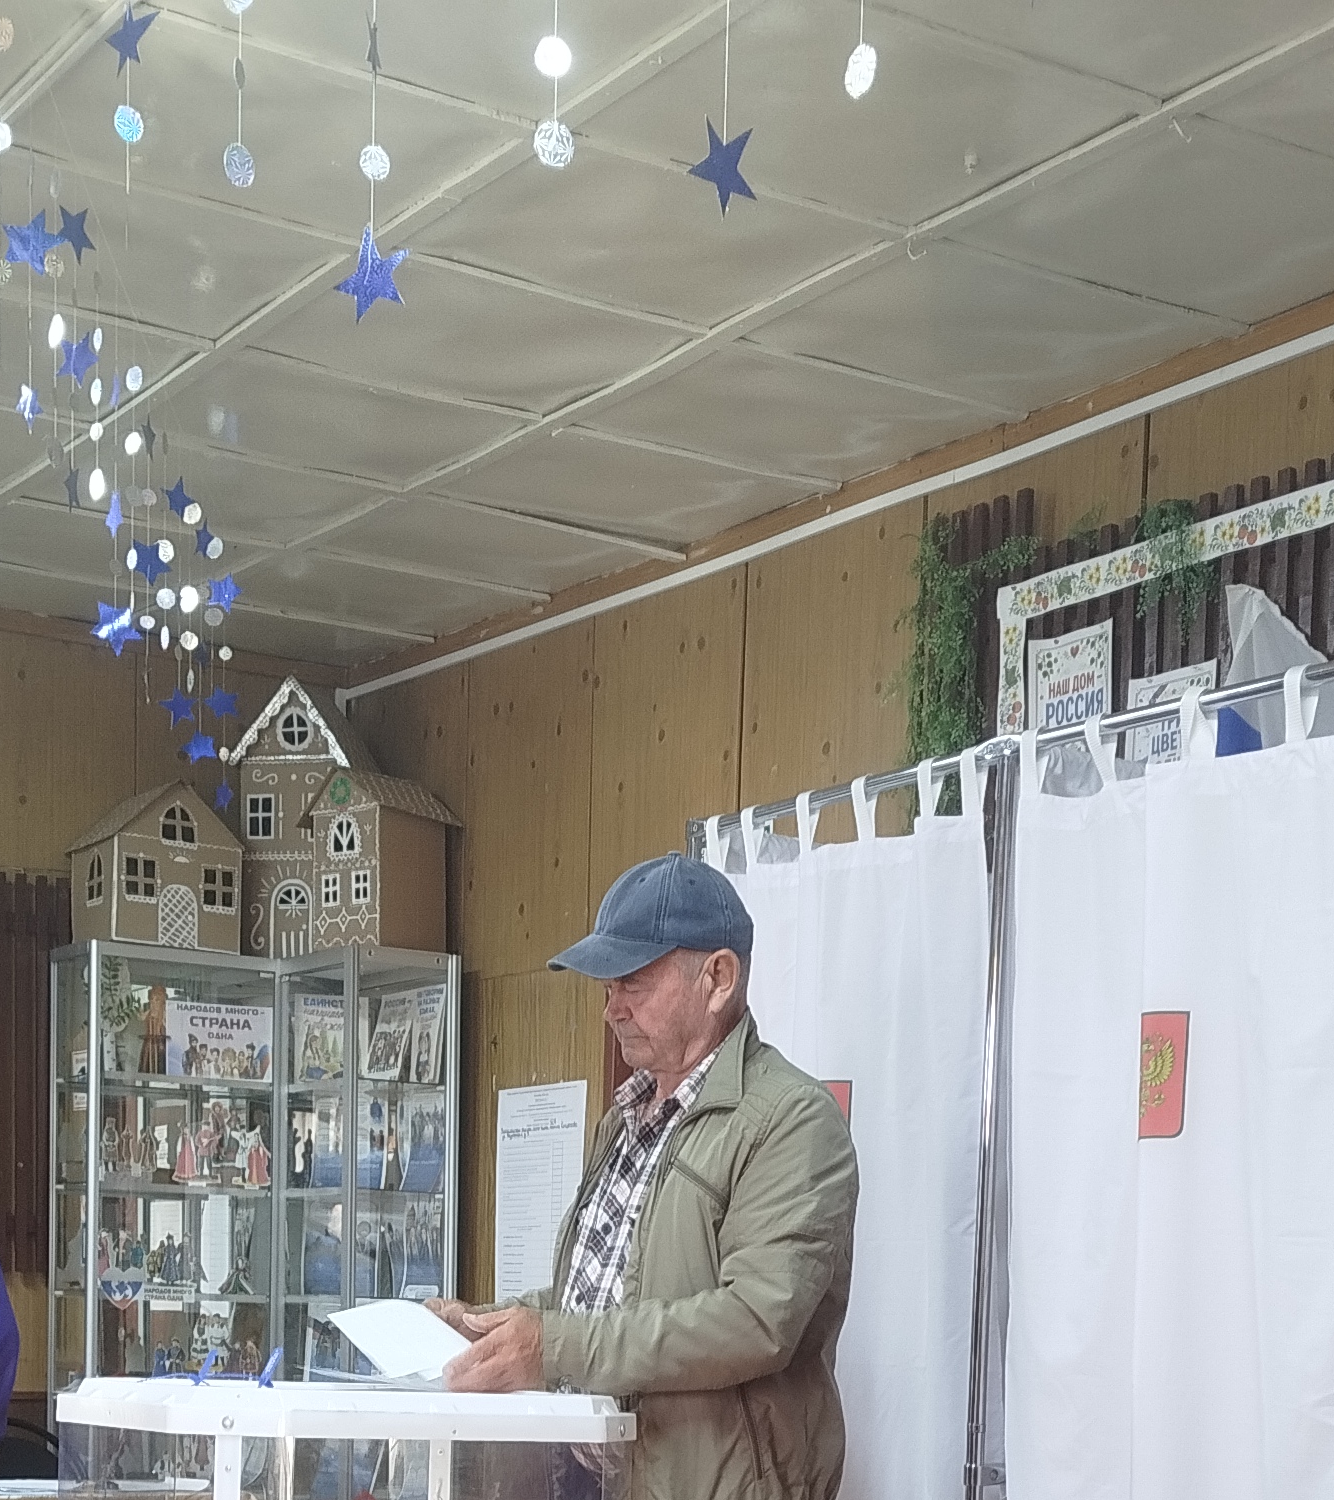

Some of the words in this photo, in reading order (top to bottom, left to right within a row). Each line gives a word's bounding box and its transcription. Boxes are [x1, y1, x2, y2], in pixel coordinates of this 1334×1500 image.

[1048, 679, 1070, 699] НАШ
[1071, 671, 1096, 693] ДОМ
[1045, 687, 1104, 727] РОССИЯ
[176, 1003, 222, 1014] НАРОДОВ
[225, 1007, 259, 1016] МНОГО
[189, 1015, 252, 1030] СТРАНА
[207, 1031, 234, 1040] ОДНА
